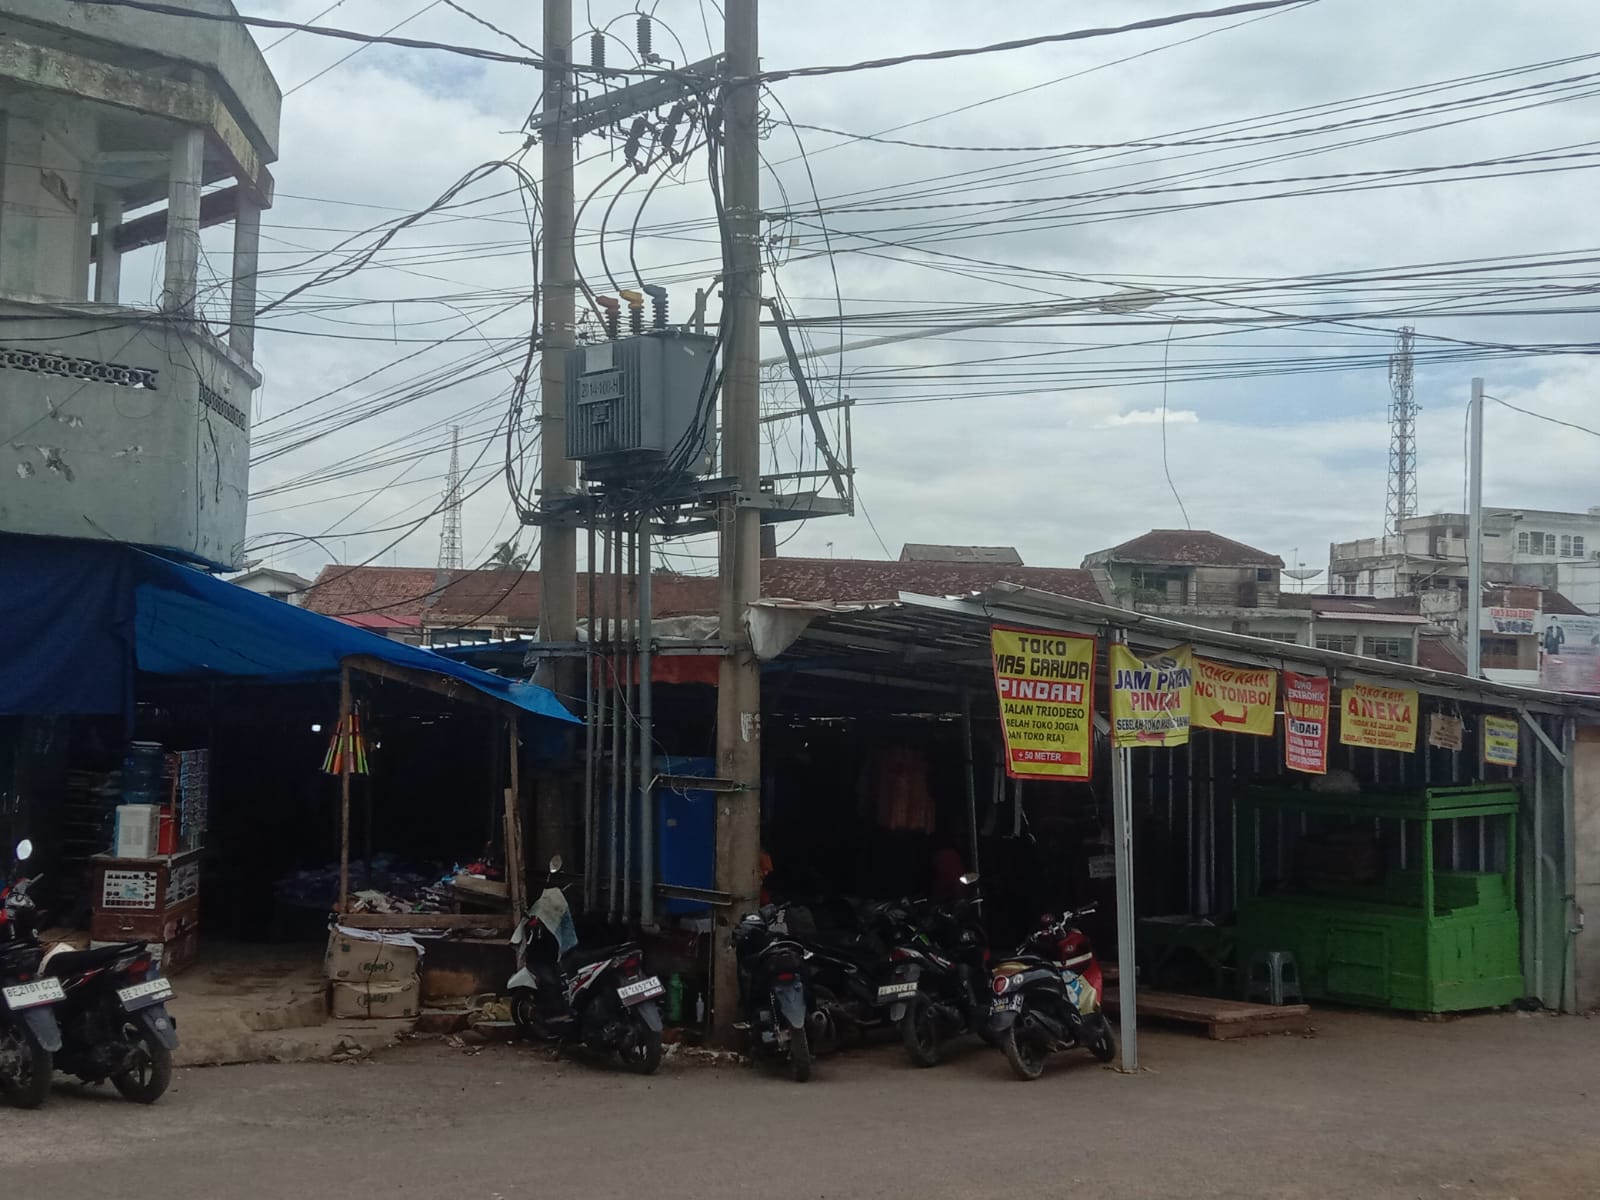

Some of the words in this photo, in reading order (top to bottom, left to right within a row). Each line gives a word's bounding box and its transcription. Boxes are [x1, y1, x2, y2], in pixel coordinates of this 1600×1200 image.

[1018, 637, 1067, 656] TOKO
[1030, 657, 1090, 680] GARUDA
[1198, 662, 1235, 682] TOKO
[1114, 670, 1152, 690] JAM
[1000, 679, 1081, 702] PINDAH
[1355, 684, 1380, 699] TOKO
[1004, 703, 1034, 716] JALAN
[1036, 705, 1085, 719] TRIODESO
[1348, 696, 1412, 724] ANEKA
[1032, 720, 1053, 730] TOKO
[1054, 721, 1079, 732] JOGJA
[1023, 731, 1045, 741] TOKO
[1024, 752, 1034, 760] 50
[1034, 752, 1062, 761] METER
